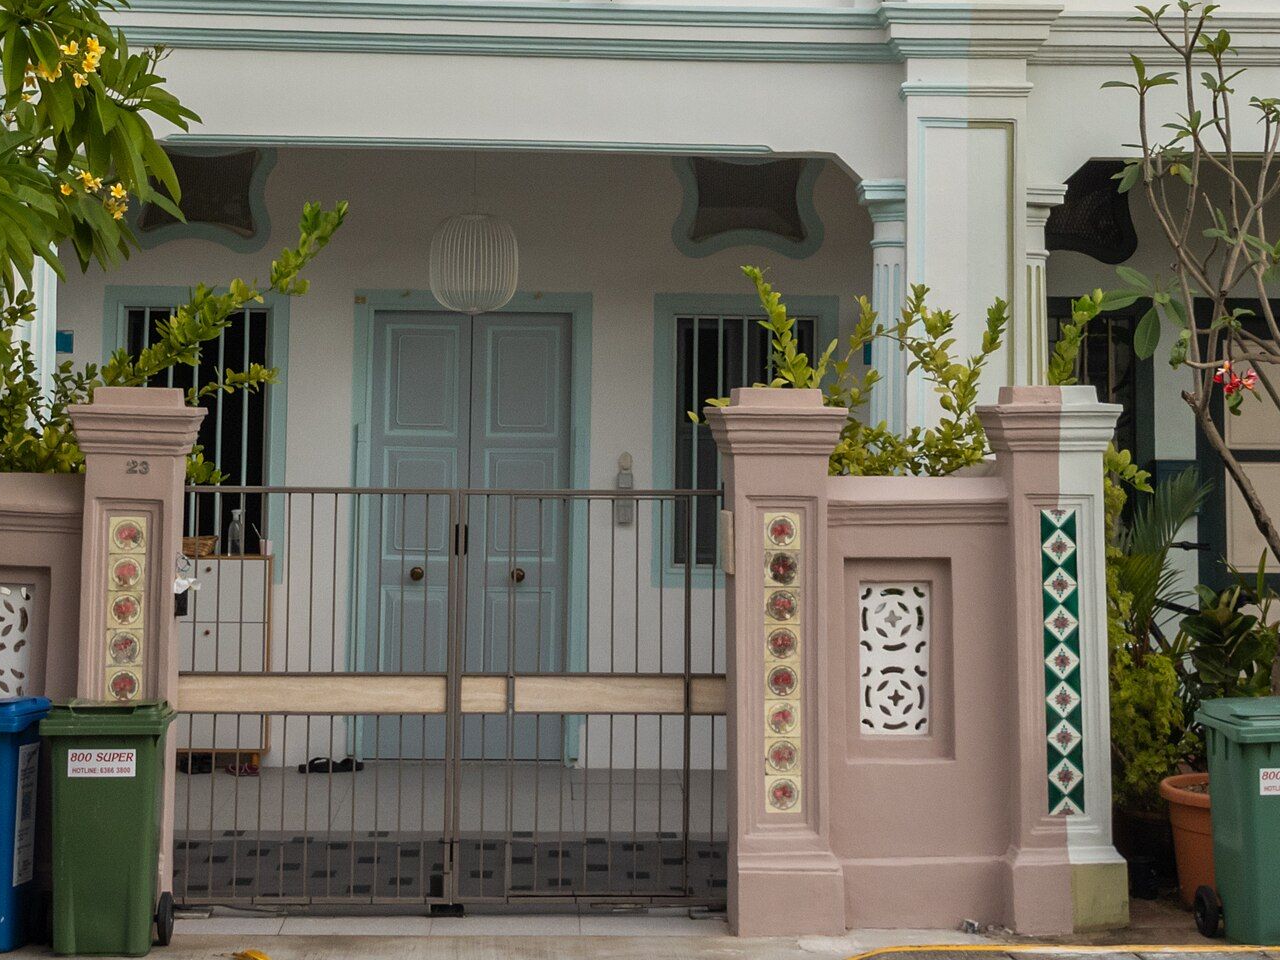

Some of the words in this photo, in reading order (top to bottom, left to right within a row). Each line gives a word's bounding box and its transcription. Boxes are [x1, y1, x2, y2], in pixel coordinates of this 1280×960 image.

[126, 460, 150, 475] 23
[70, 752, 93, 762] 800
[96, 752, 134, 762] SUPER
